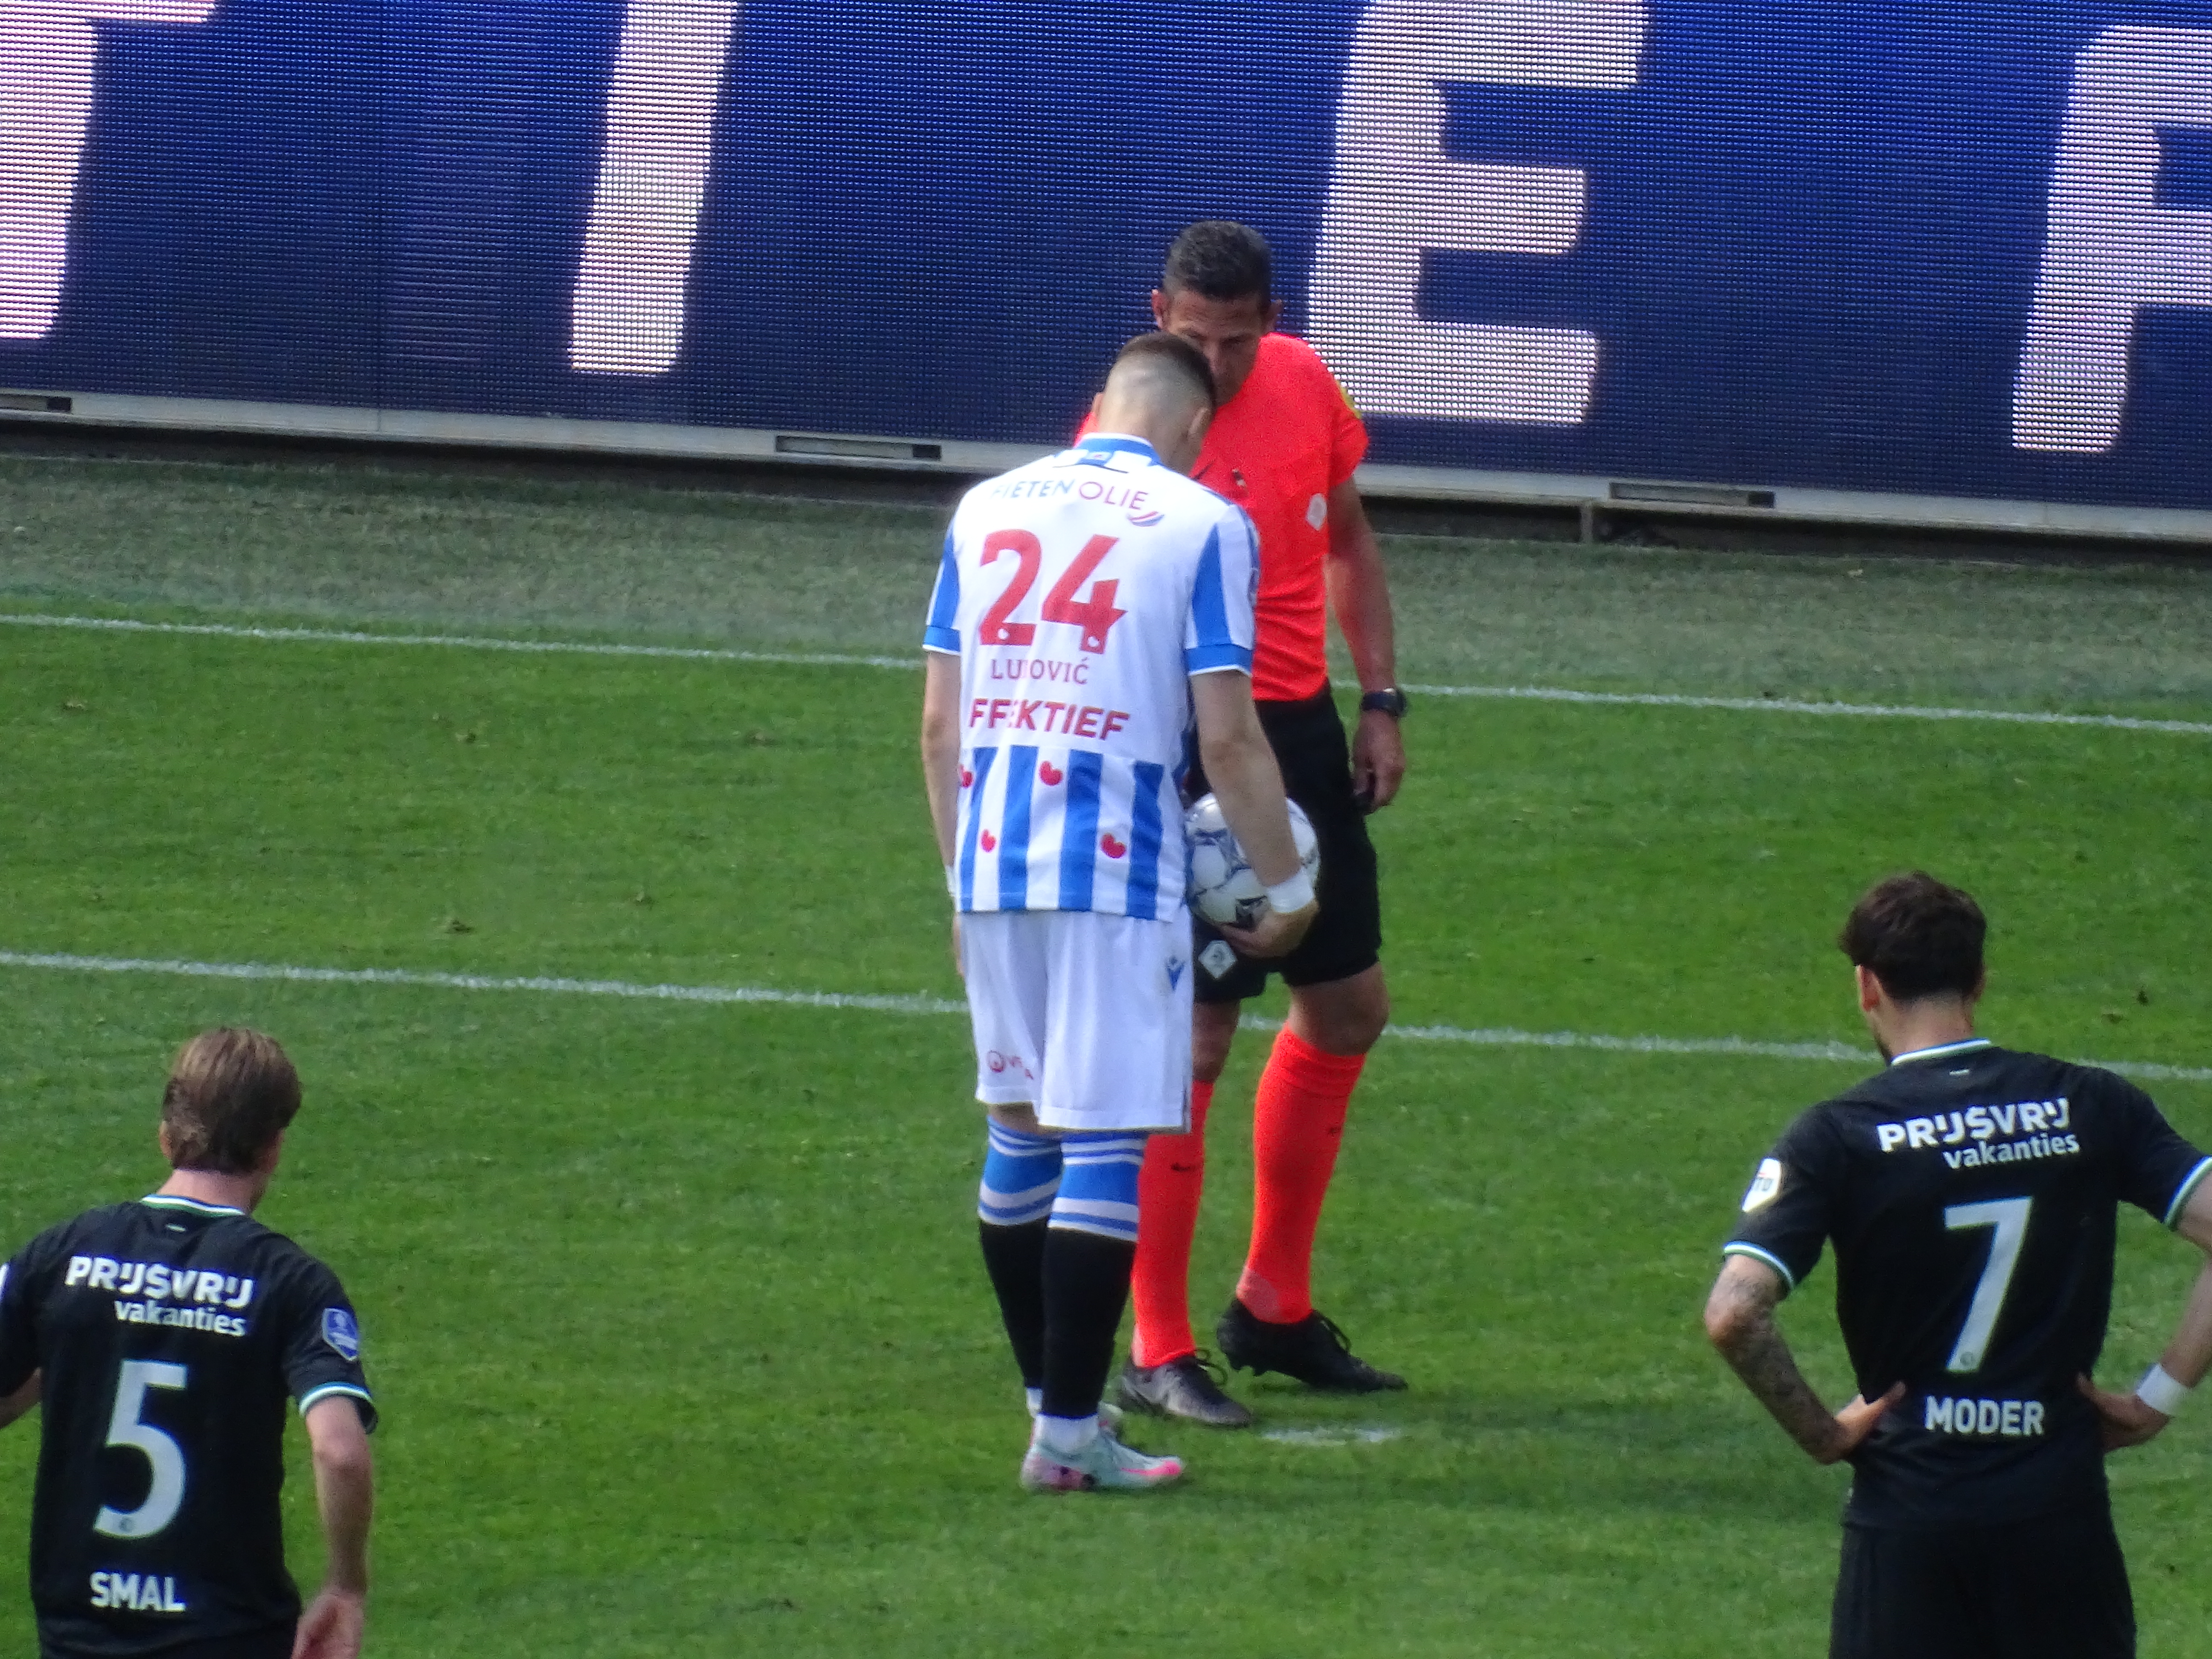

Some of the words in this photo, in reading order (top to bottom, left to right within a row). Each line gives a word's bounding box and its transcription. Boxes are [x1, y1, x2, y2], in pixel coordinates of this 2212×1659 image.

[1078, 481, 1149, 511] OLIE
[978, 529, 1129, 654] 24
[990, 657, 1089, 684] LUOVIĆ
[969, 698, 1130, 740] FFKTIEF
[1942, 1132, 2080, 1169] vakanties
[1944, 1195, 2034, 1374] 7
[114, 1299, 247, 1337] vakanties
[1924, 1395, 2045, 1436] MODER
[93, 1358, 189, 1539] 5
[90, 1570, 186, 1612] SMAL
